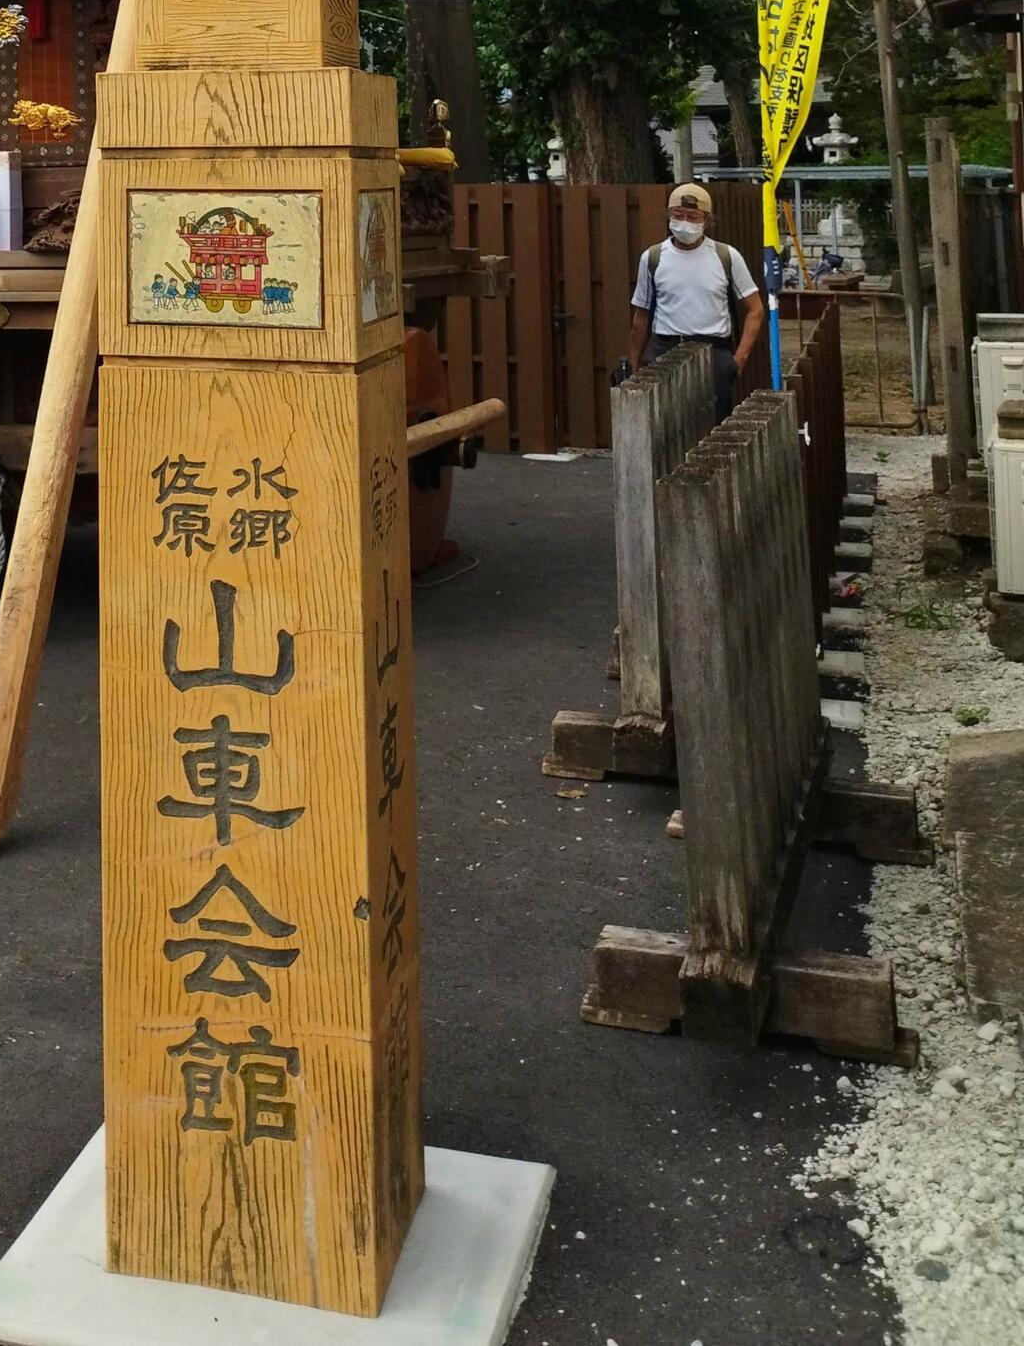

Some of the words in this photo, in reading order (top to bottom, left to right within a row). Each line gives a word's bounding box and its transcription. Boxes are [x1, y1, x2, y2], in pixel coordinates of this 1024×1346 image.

[151, 453, 218, 557] 佐原
[157, 579, 306, 1146] 山車会館
